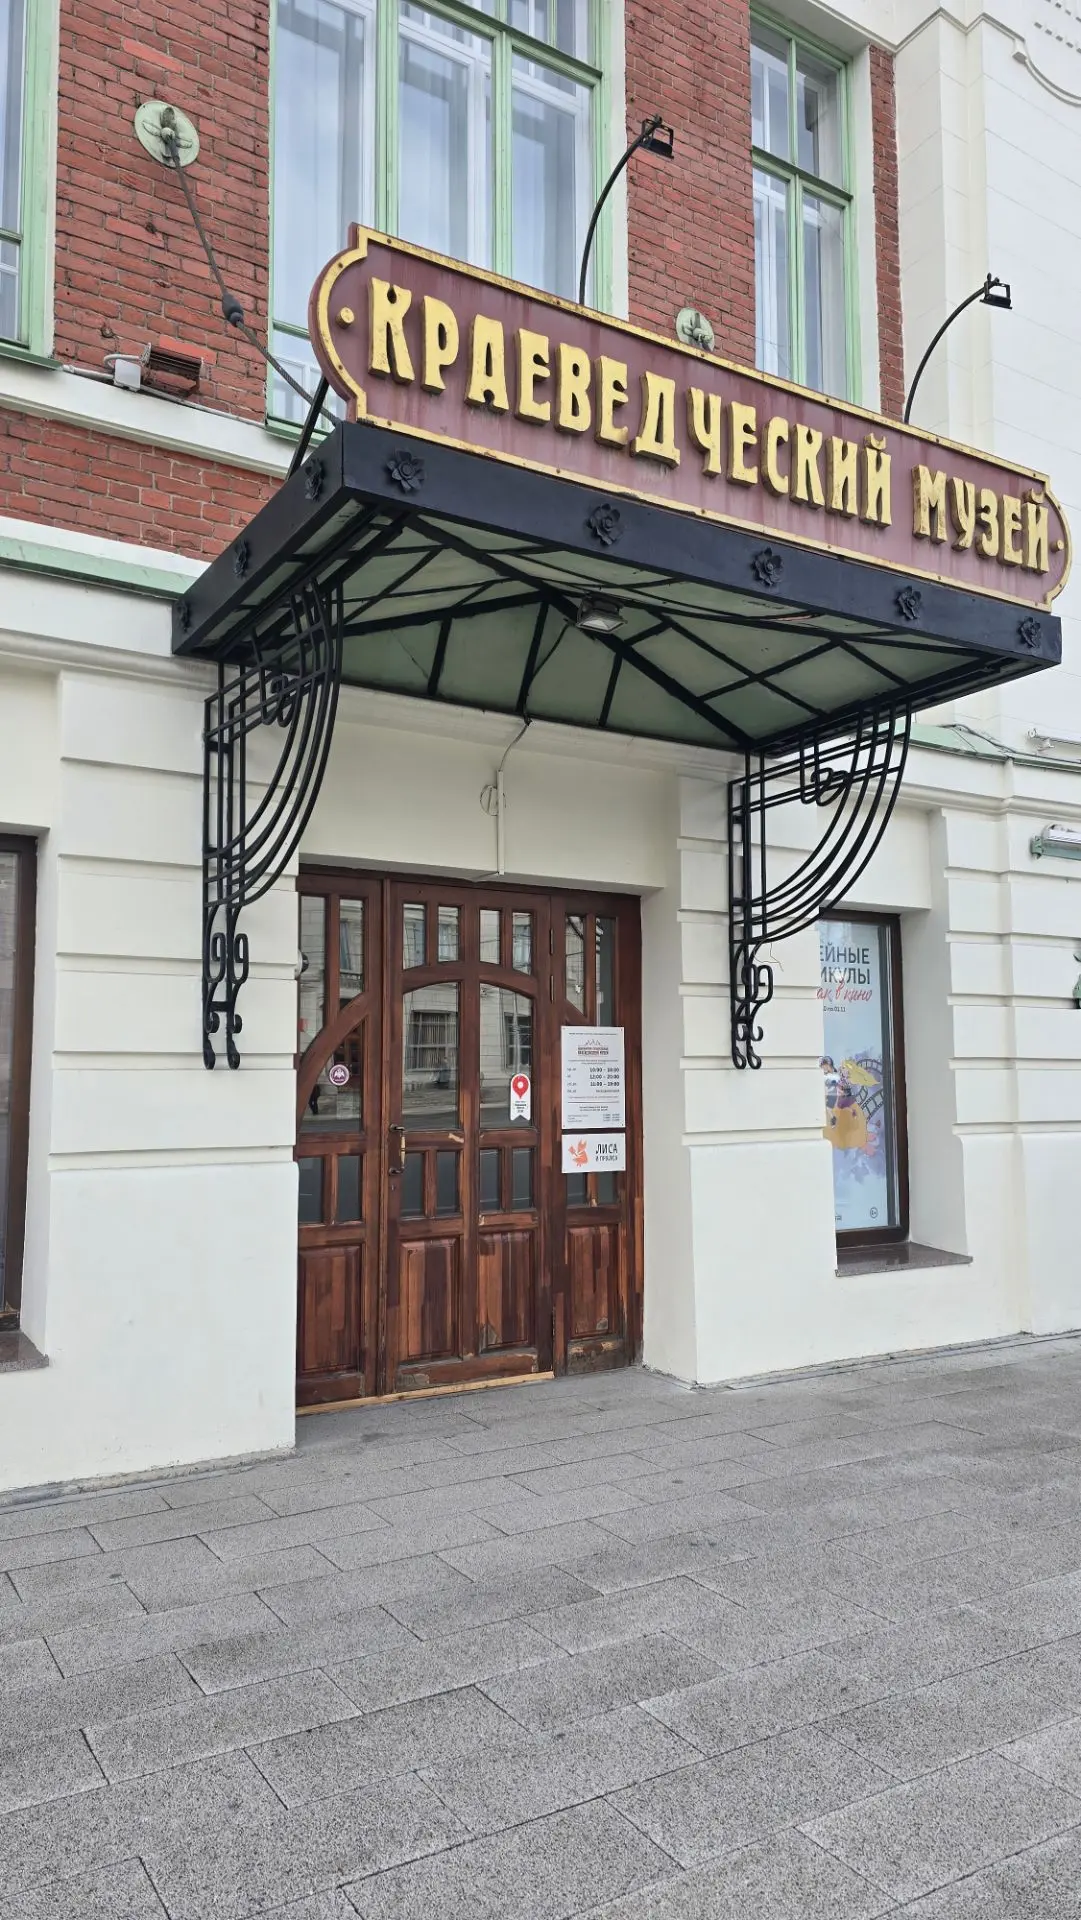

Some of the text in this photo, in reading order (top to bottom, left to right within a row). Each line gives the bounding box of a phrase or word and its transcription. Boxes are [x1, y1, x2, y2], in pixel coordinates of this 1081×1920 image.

[367, 276, 1050, 575] КРАЕВЕДЧЕСКИЙ МУЗЕЙ
[595, 1143, 618, 1155] ЛИСА
